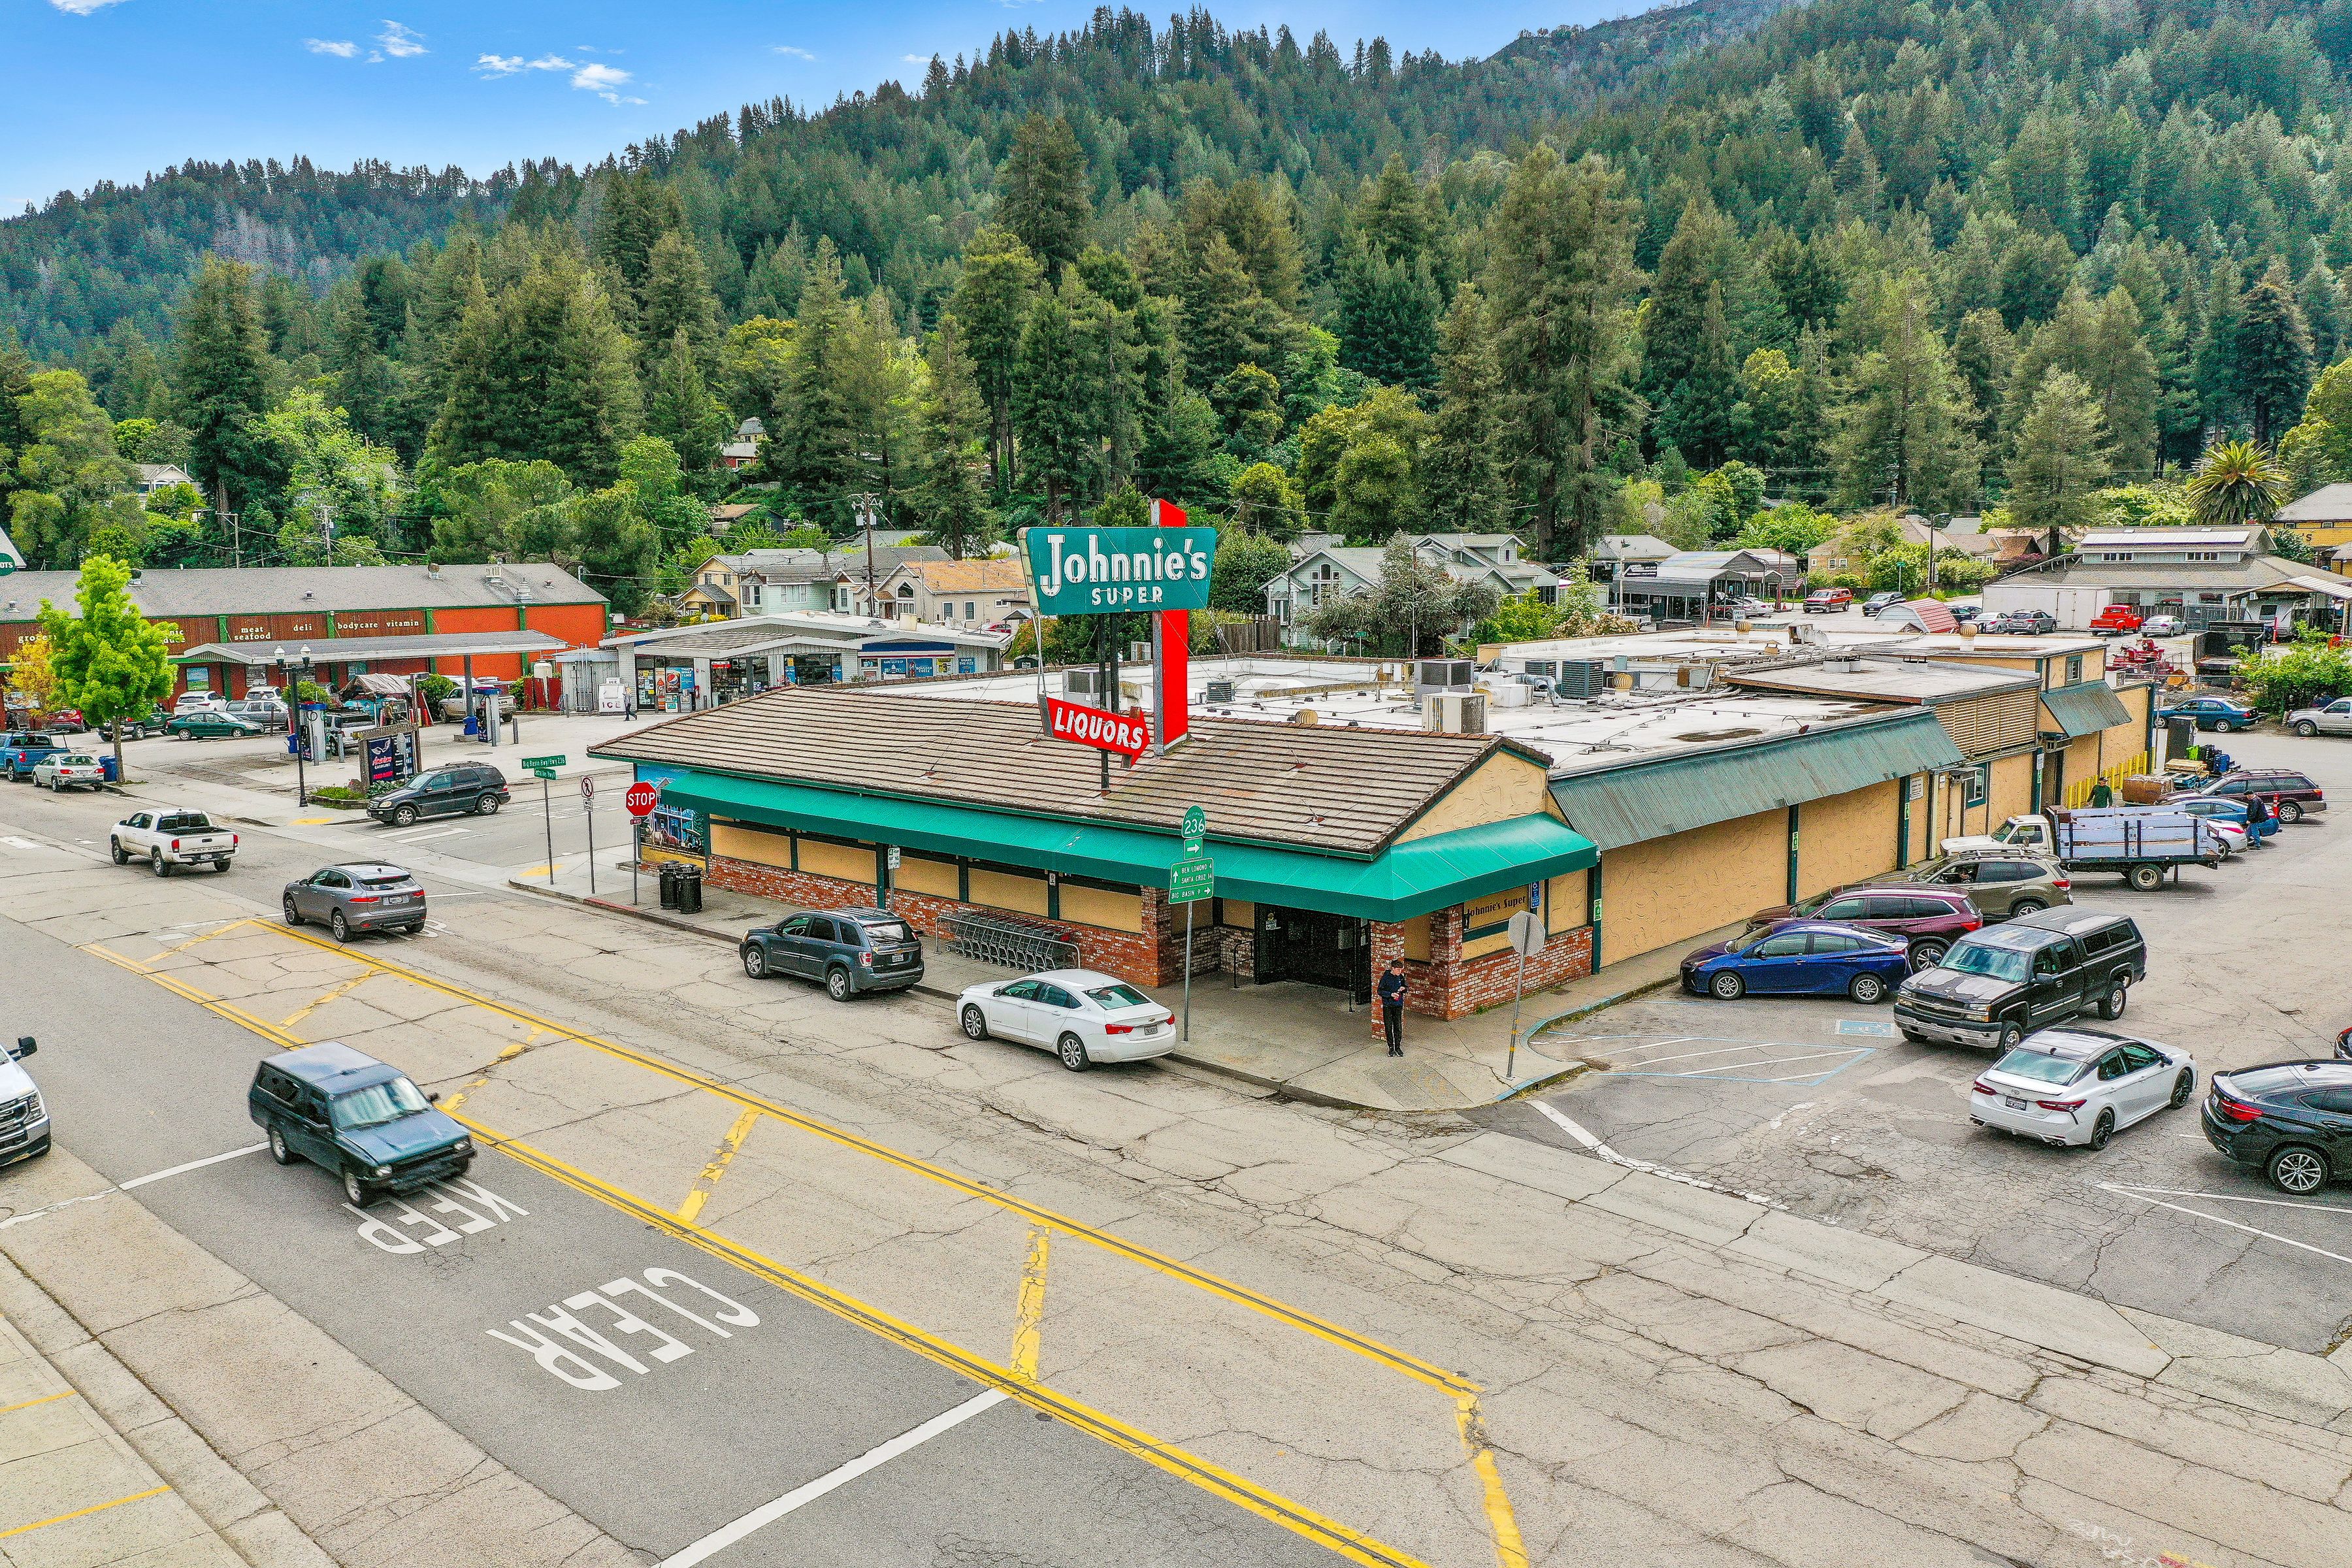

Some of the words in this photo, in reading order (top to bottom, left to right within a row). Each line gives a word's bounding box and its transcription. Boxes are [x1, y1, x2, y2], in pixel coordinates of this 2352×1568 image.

[1040, 534, 1207, 597] Johnnie's
[1092, 585, 1163, 606] SUPER
[234, 632, 271, 641] seafood
[1054, 706, 1143, 750] LIQUORS
[628, 792, 655, 806] STOP
[1184, 818, 1205, 834] 236
[1191, 864, 1207, 872] LOMOND
[1467, 902, 1501, 917] Johnnie's
[1503, 896, 1526, 909] Super
[342, 1177, 530, 1254] KEEP
[485, 1267, 760, 1391] CLEAR
